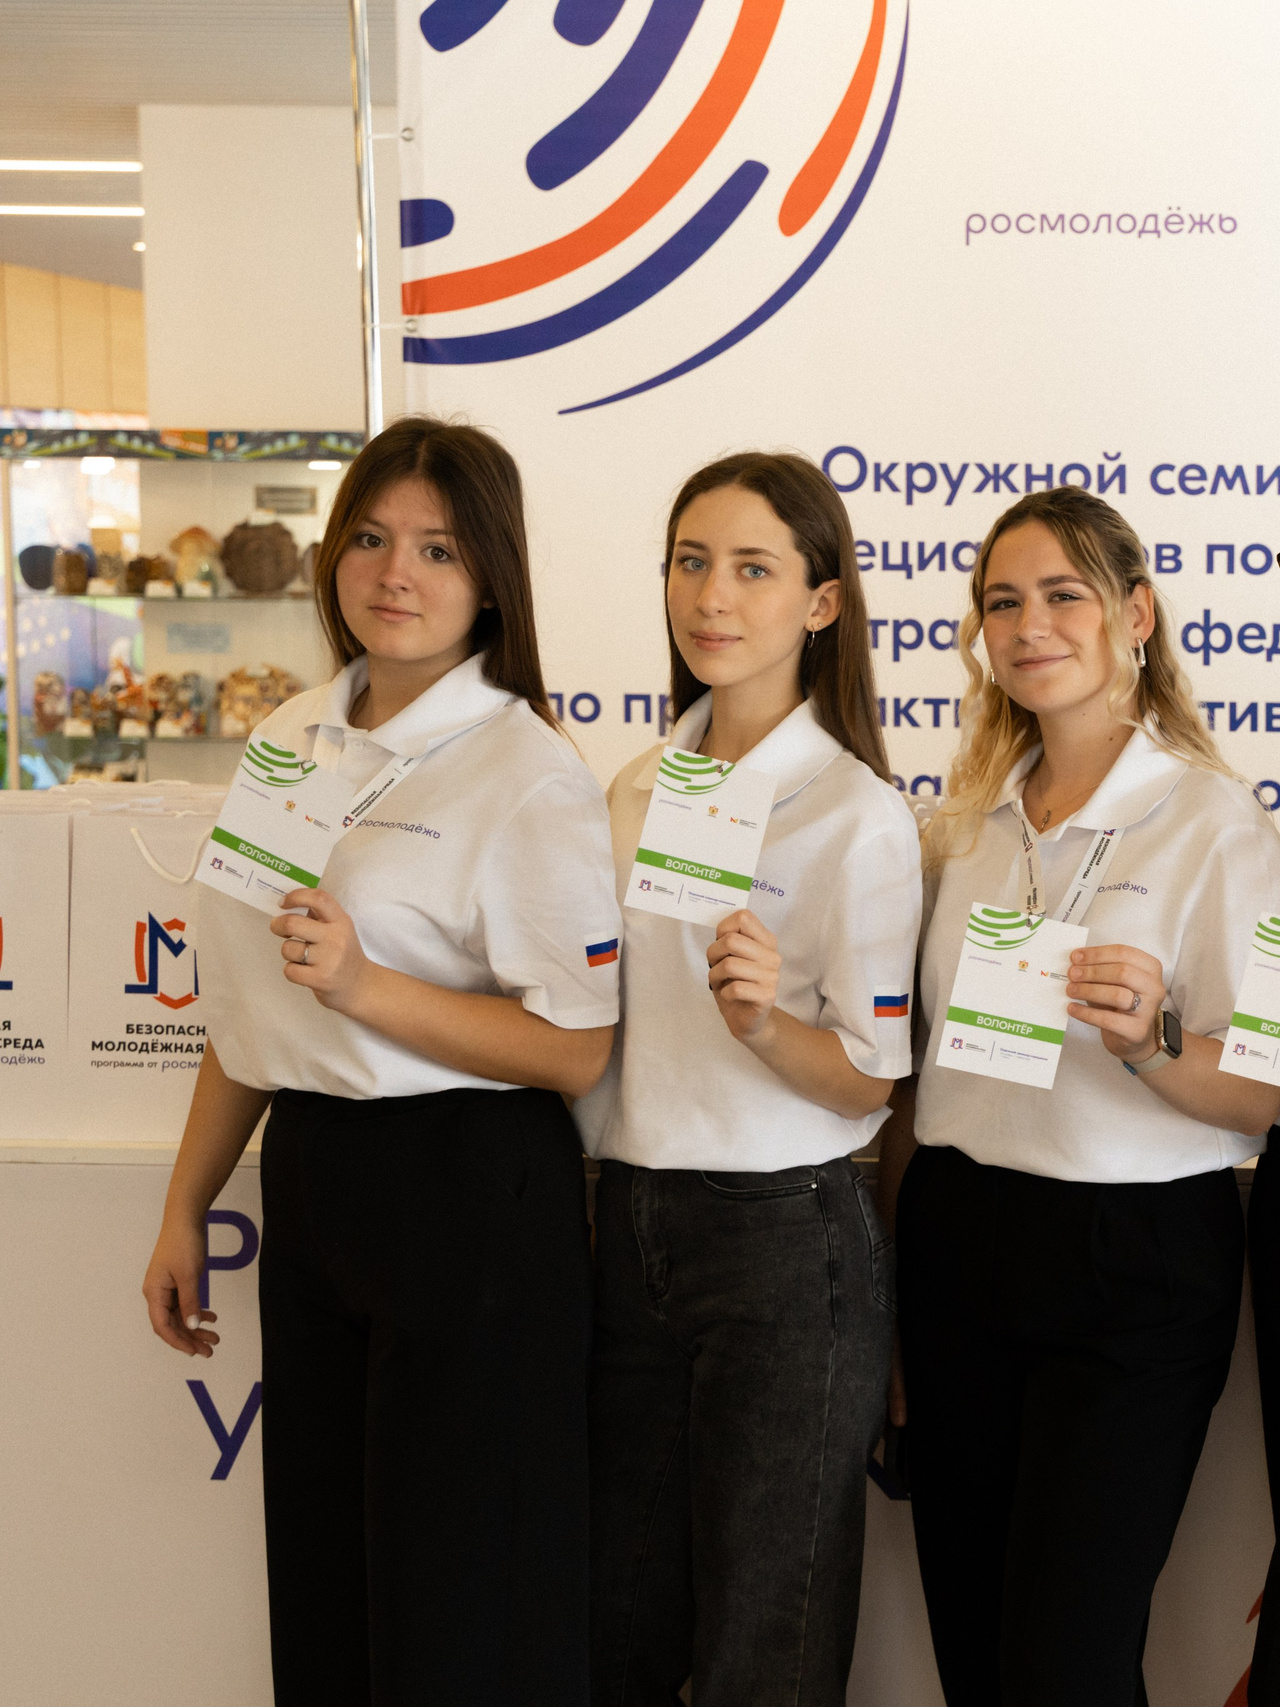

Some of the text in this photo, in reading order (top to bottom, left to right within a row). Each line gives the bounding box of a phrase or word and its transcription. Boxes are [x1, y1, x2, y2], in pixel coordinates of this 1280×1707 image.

[965, 205, 1238, 247] росмолодёжь
[821, 445, 1128, 506] Окружной
[1205, 543, 1274, 576] по
[355, 818, 441, 840] росмолодёжь
[237, 841, 292, 874] ВОЛОНТЁР
[664, 857, 723, 881] ВОЛОНТЁР
[1097, 881, 1148, 895] олодёжь
[125, 1023, 207, 1036] БЕЗОПАСН
[975, 1014, 1034, 1036] ВОЛОНТЁР
[91, 1038, 205, 1055] МОЛОДЁЖНАЯ
[90, 1060, 144, 1069] программа
[147, 1060, 159, 1069] от
